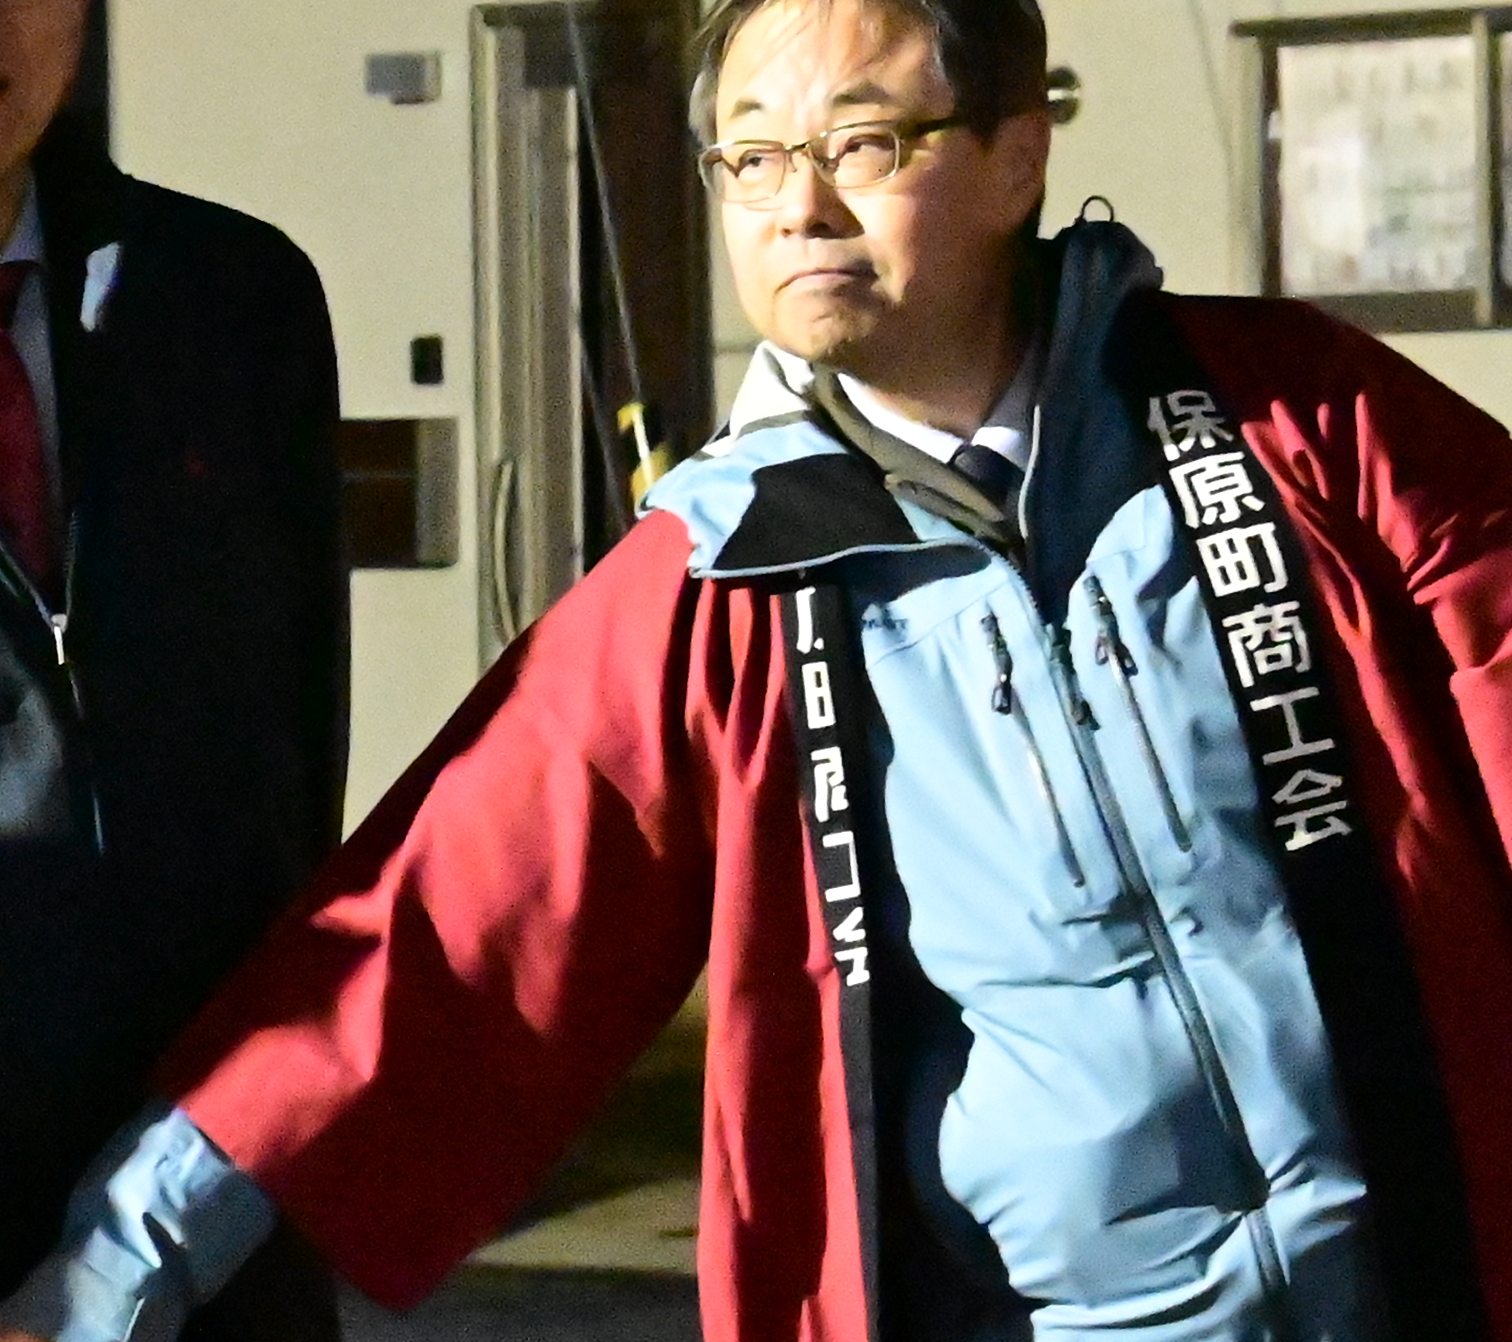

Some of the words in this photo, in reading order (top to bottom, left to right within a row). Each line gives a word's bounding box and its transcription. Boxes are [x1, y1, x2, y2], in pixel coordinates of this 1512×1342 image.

[1148, 390, 1352, 852] 保原町商工会
